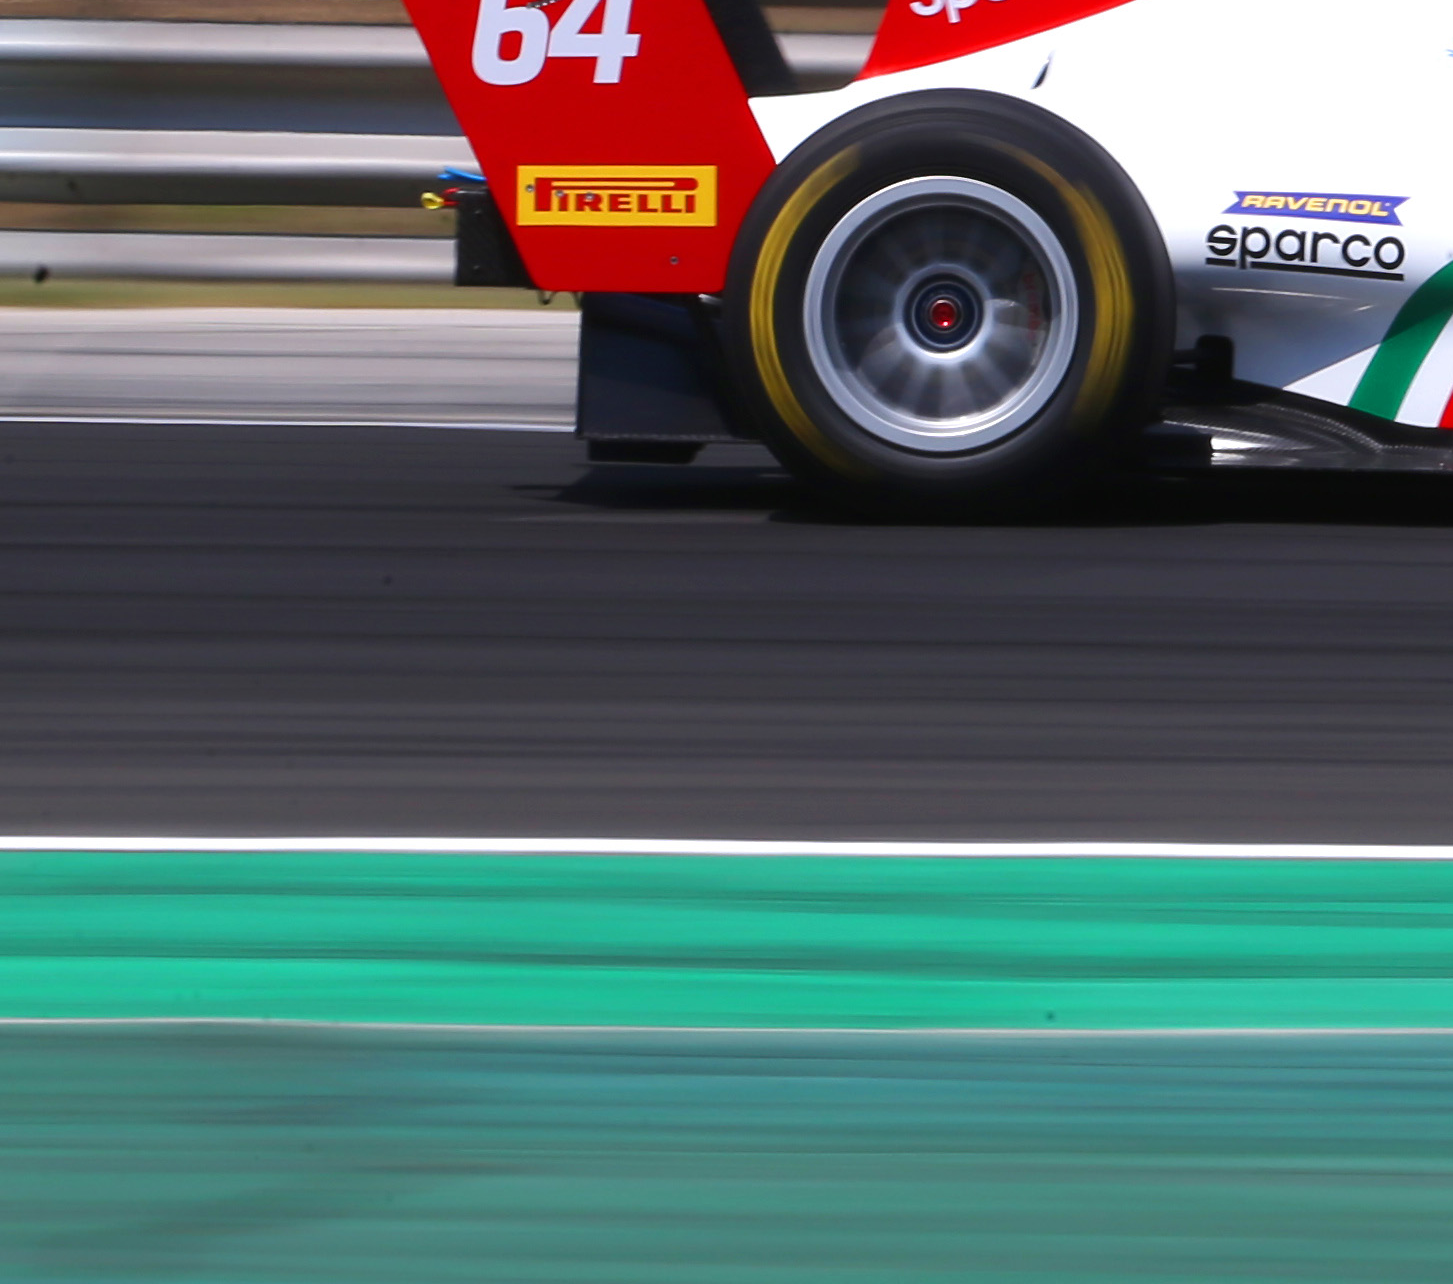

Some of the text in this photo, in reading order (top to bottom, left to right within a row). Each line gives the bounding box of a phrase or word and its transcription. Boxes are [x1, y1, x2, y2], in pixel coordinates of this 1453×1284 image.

[534, 177, 699, 214] PIRELLI
[1241, 195, 1390, 217] RAVENOL
[1206, 224, 1405, 271] sparco
